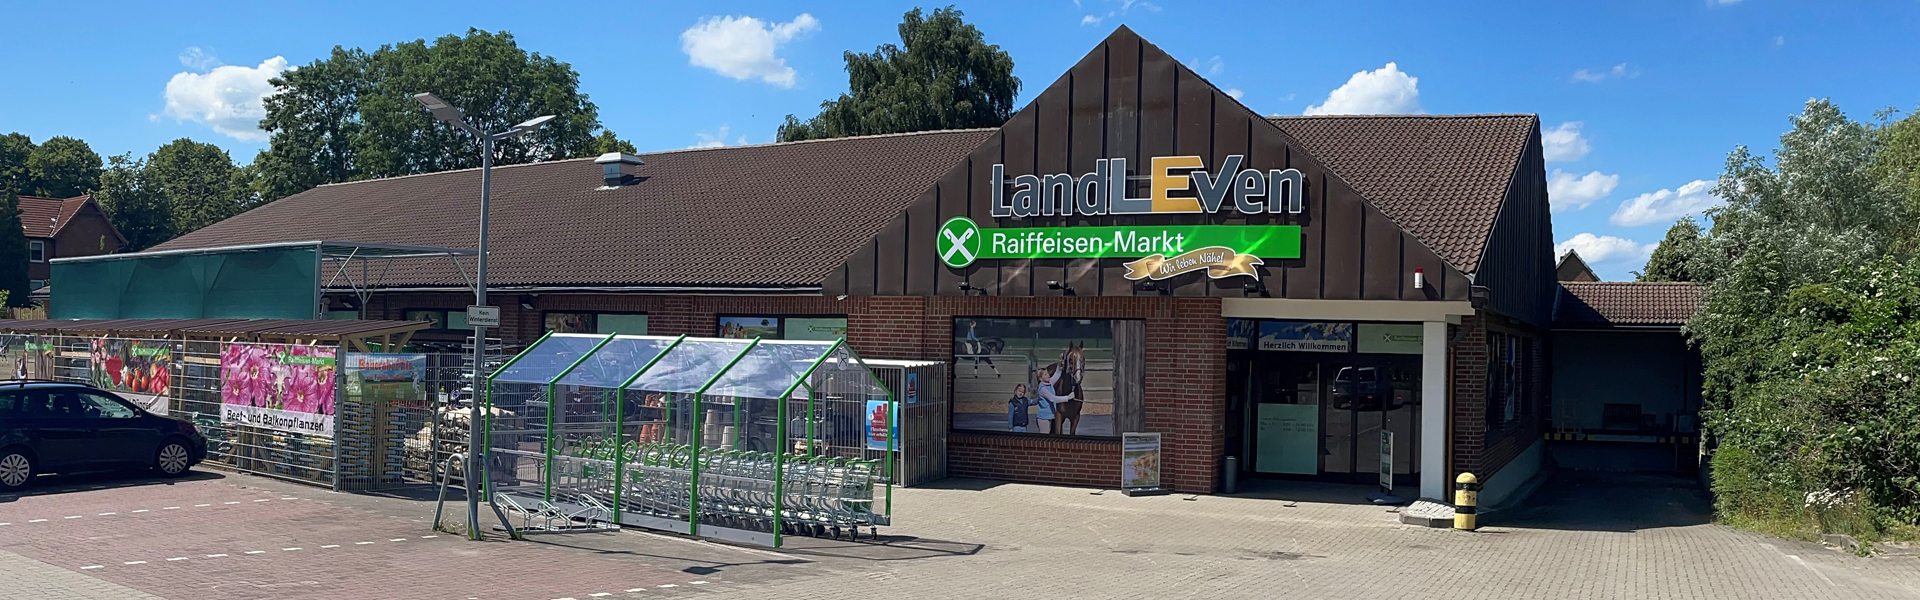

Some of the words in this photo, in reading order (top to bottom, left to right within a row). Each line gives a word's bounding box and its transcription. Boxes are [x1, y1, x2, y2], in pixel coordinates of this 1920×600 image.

[992, 230, 1184, 254] Raiffeisen-Markt
[1160, 263, 1176, 275] Wir
[1176, 259, 1197, 269] leben
[1200, 252, 1224, 265] Nähe!
[1263, 341, 1296, 350] Herzlich
[1298, 342, 1346, 351] Willkommen
[226, 409, 247, 421] Beet-
[247, 412, 261, 424] und
[263, 414, 324, 432] Balkonpflanzen
